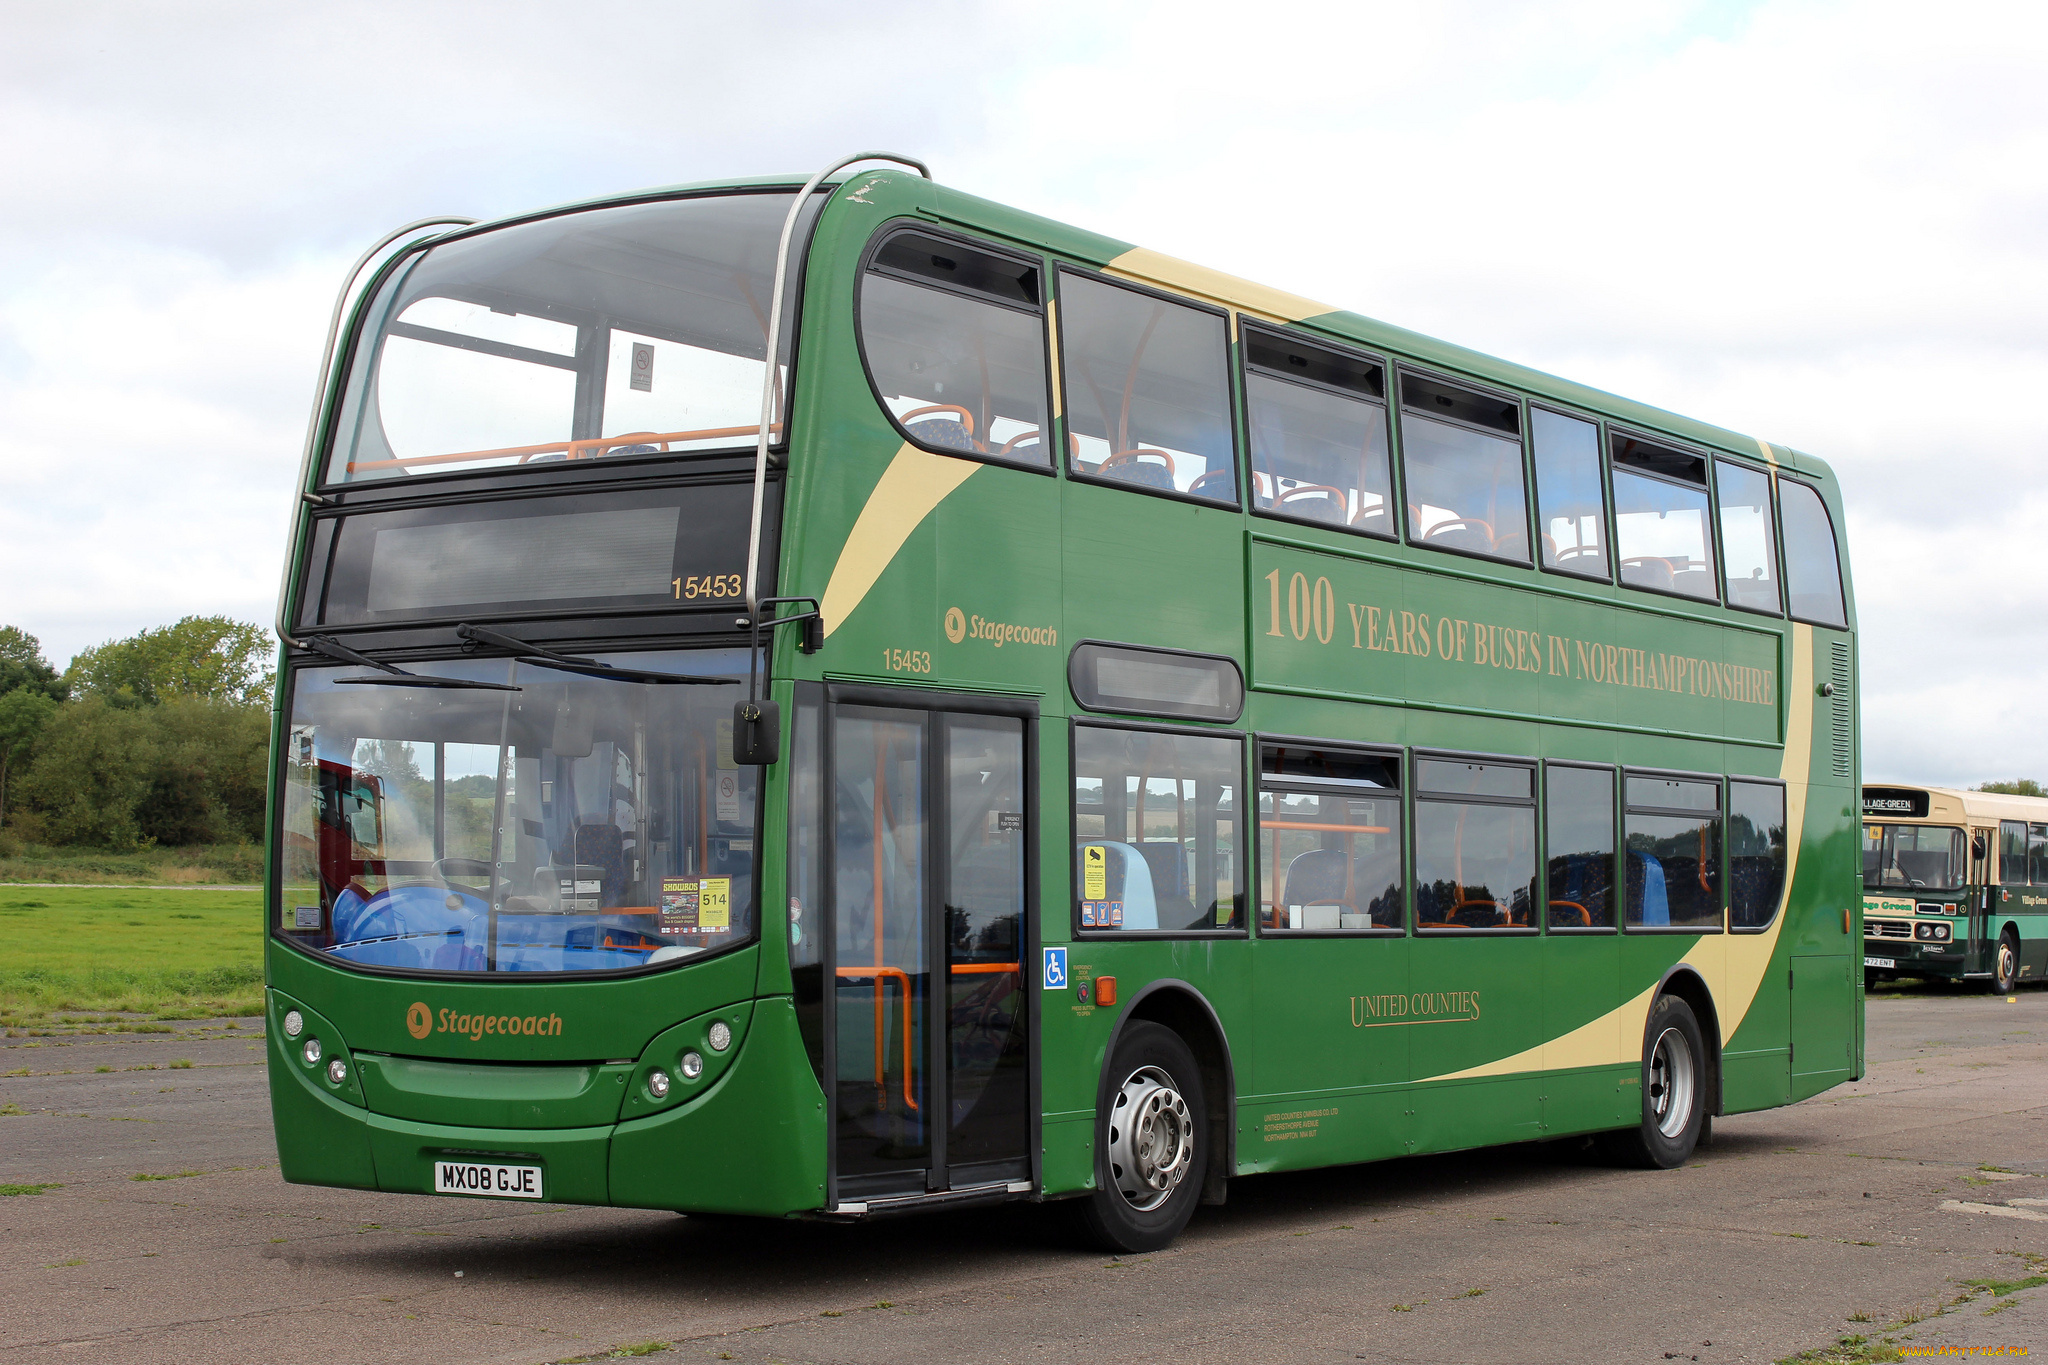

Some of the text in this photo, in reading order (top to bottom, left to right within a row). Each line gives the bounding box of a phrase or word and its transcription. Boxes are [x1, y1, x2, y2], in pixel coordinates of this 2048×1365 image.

[671, 574, 743, 600] 15453
[969, 613, 1058, 649] Stagecoach
[1264, 567, 1775, 706] 100 YEARS OF BUSES IN NORTHAMPTONSHIRE
[883, 648, 932, 674] 15453
[1862, 799, 1911, 808] LLAGE-GREEN
[702, 893, 727, 906] 514
[1882, 901, 1913, 911] Green
[1863, 958, 1892, 967] 472 ENT
[1350, 990, 1480, 1028] UNITED COUNTIES
[437, 1007, 563, 1041] Stagecoach
[1263, 1113, 1280, 1122] UNITED
[1280, 1111, 1302, 1120] COUNTIES
[1263, 1132, 1299, 1142] NORTHAMPTON
[442, 1165, 535, 1193] MX08 GJE
